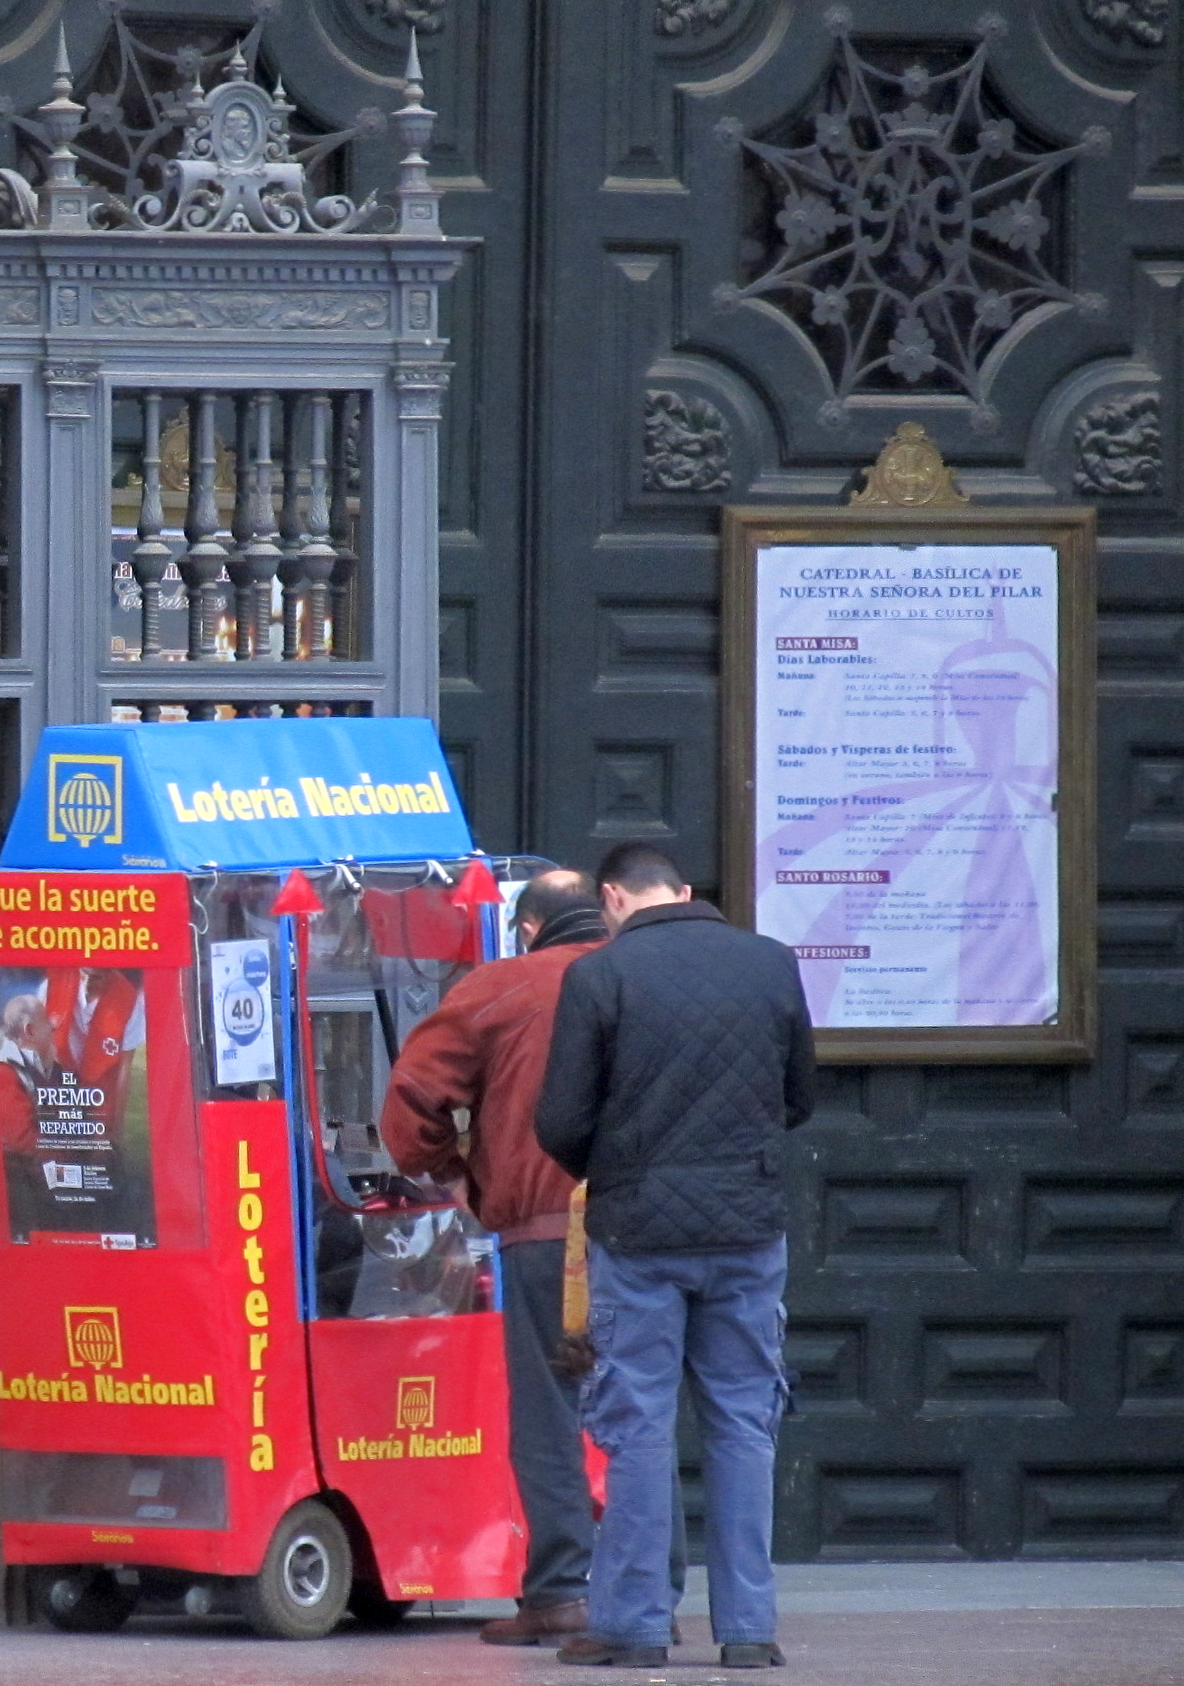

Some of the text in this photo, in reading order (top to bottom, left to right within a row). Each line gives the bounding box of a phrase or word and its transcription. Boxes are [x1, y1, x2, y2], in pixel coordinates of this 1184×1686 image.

[800, 568, 896, 580] CATEDRAL
[912, 566, 992, 580] BASÍLICA
[998, 568, 1023, 580] DE
[779, 584, 1044, 598] NUESTRA SEÑORA DEL PILAR
[827, 608, 995, 619] HORARIO DE CULTOS
[777, 639, 818, 649] SANTA
[807, 655, 877, 666] Laborables:
[895, 745, 910, 755] de
[167, 771, 450, 823] Lotería Nacional
[777, 795, 839, 807] Domingos
[842, 797, 848, 807] y
[777, 872, 884, 883] SANTO ROSARIO:
[39, 879, 62, 912] la
[70, 885, 156, 912] suerte
[10, 919, 159, 958] acompañe.
[795, 948, 868, 958] NFESIONES:
[232, 998, 254, 1020] 40
[62, 1072, 77, 1085] EL
[37, 1088, 105, 1107] PREMIO
[59, 1108, 83, 1120] más
[40, 1122, 105, 1135] REPARTIDO
[237, 1140, 274, 1472] Lotería
[94, 1374, 215, 1405] Nacional
[337, 1428, 482, 1461] Lotería Nacional
